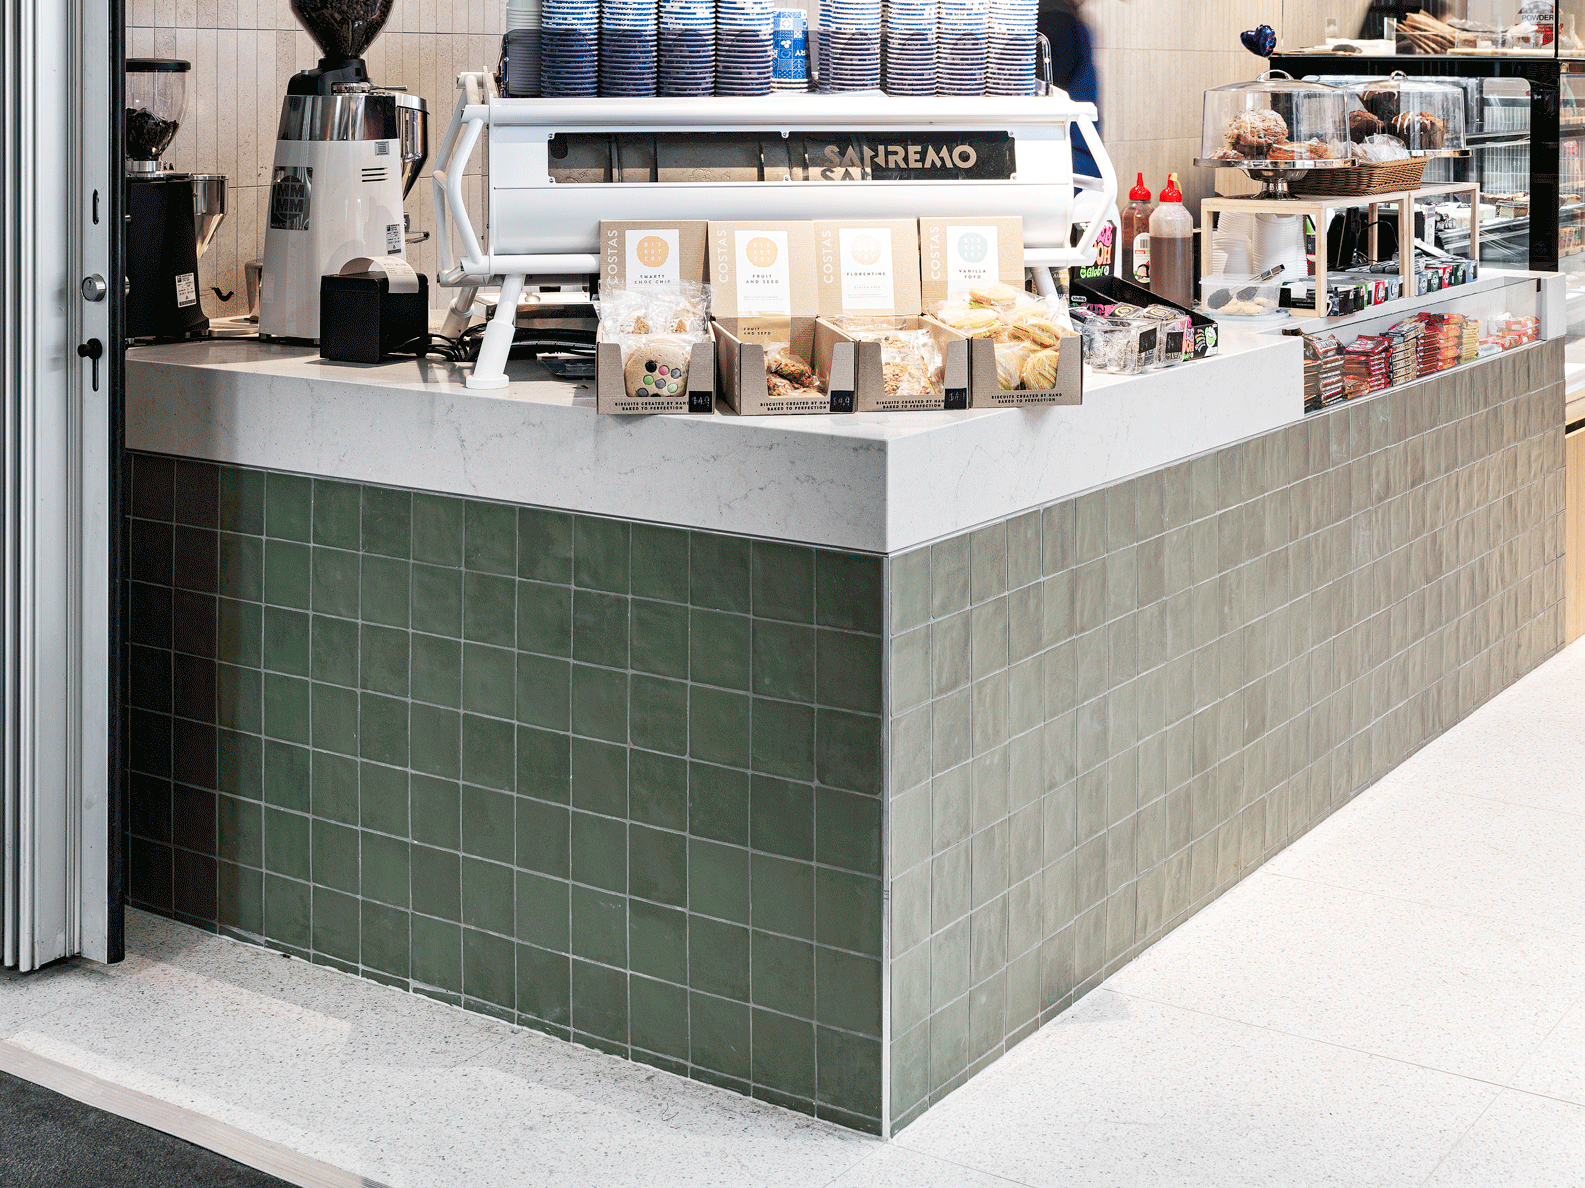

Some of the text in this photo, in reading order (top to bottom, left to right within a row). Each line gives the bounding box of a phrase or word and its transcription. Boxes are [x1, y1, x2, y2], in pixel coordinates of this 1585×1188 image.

[823, 144, 977, 169] SANREMO
[607, 229, 618, 285] COSTAS
[716, 229, 729, 283] COSTAS
[821, 230, 833, 284] COSTAS
[929, 226, 940, 280] COSTAS
